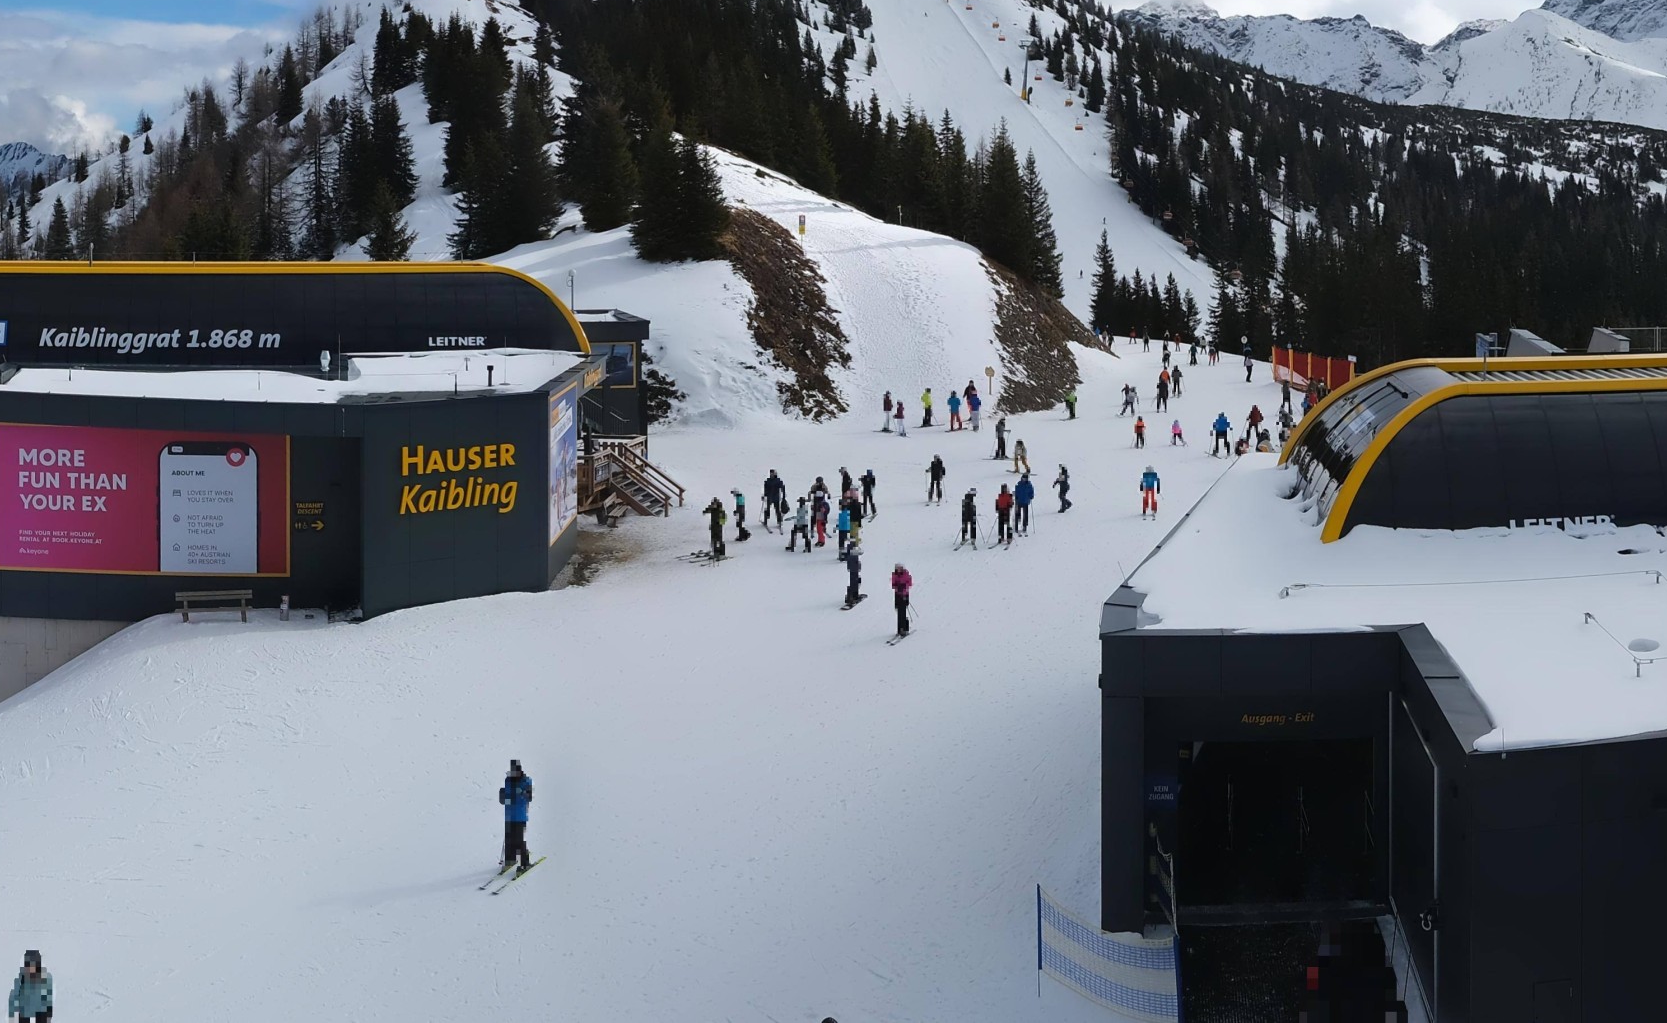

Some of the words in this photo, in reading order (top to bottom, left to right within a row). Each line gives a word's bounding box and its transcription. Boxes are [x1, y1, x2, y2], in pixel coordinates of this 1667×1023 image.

[39, 327, 181, 354] Kaiblinggrat
[186, 329, 253, 348] 1.868
[258, 332, 281, 348] m
[428, 336, 485, 346] LEITNER
[18, 448, 85, 467] MORE
[401, 443, 516, 476] HAUSER
[18, 471, 60, 488] FUN
[67, 472, 127, 490] THAN
[20, 494, 75, 511] YOUR
[82, 496, 107, 512] EX
[399, 477, 518, 514] Kaibling
[1241, 713, 1286, 725] Ausgang
[1295, 712, 1315, 723] Exit
